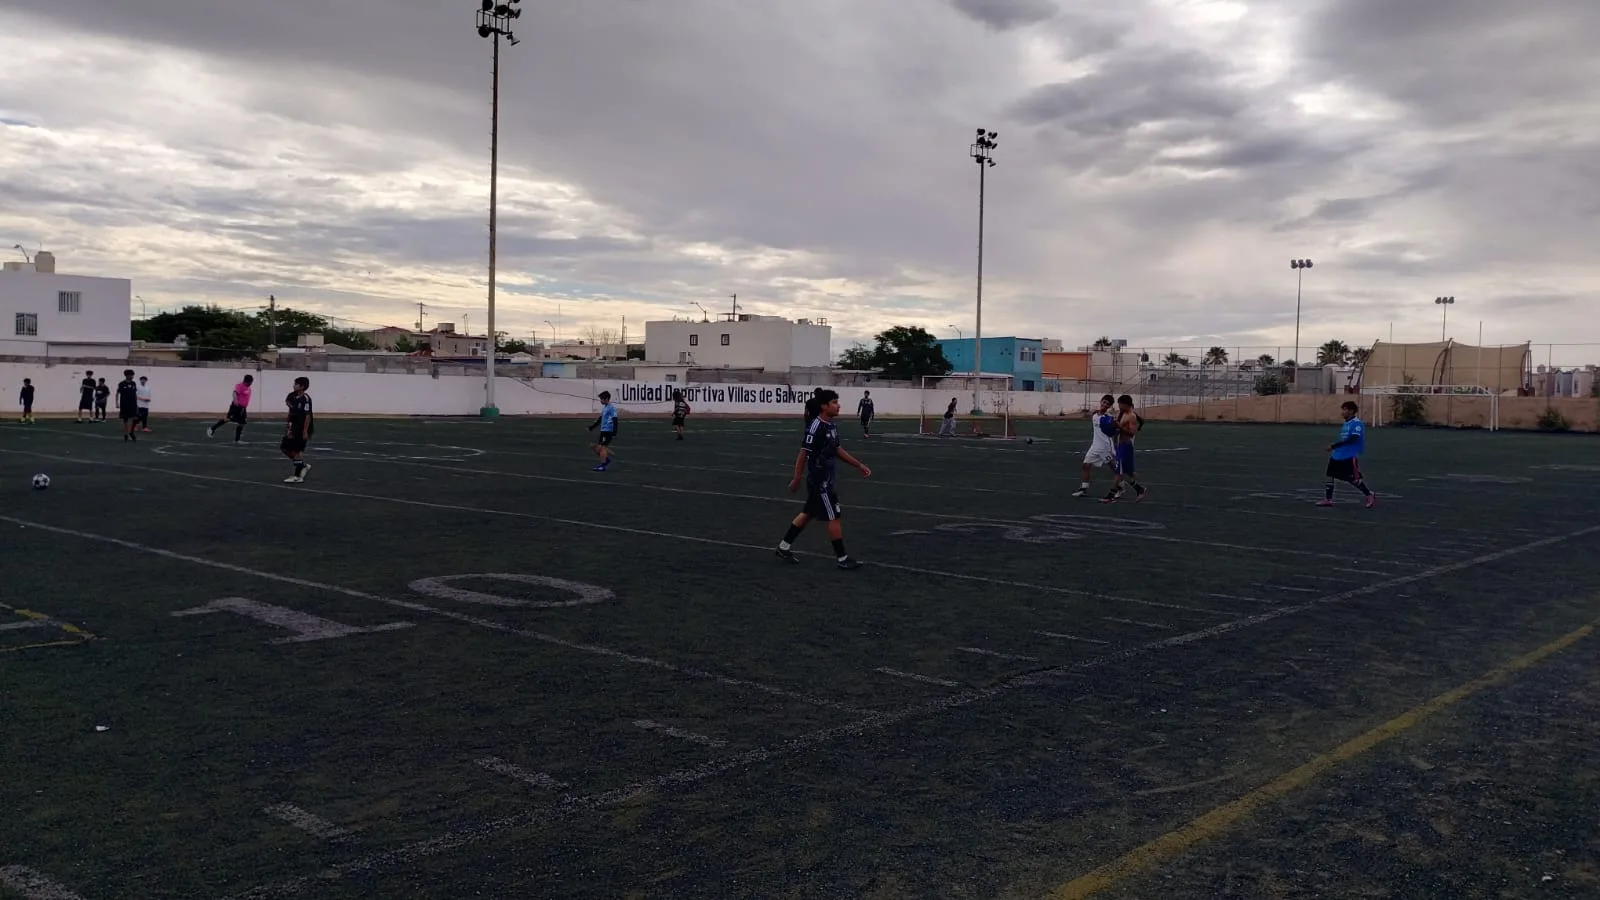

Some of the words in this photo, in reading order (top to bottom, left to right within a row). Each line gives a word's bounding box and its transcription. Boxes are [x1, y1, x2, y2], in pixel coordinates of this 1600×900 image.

[622, 383, 663, 401] Unidad
[728, 385, 757, 403] Villas
[760, 387, 773, 403] de
[169, 573, 617, 645] 10
